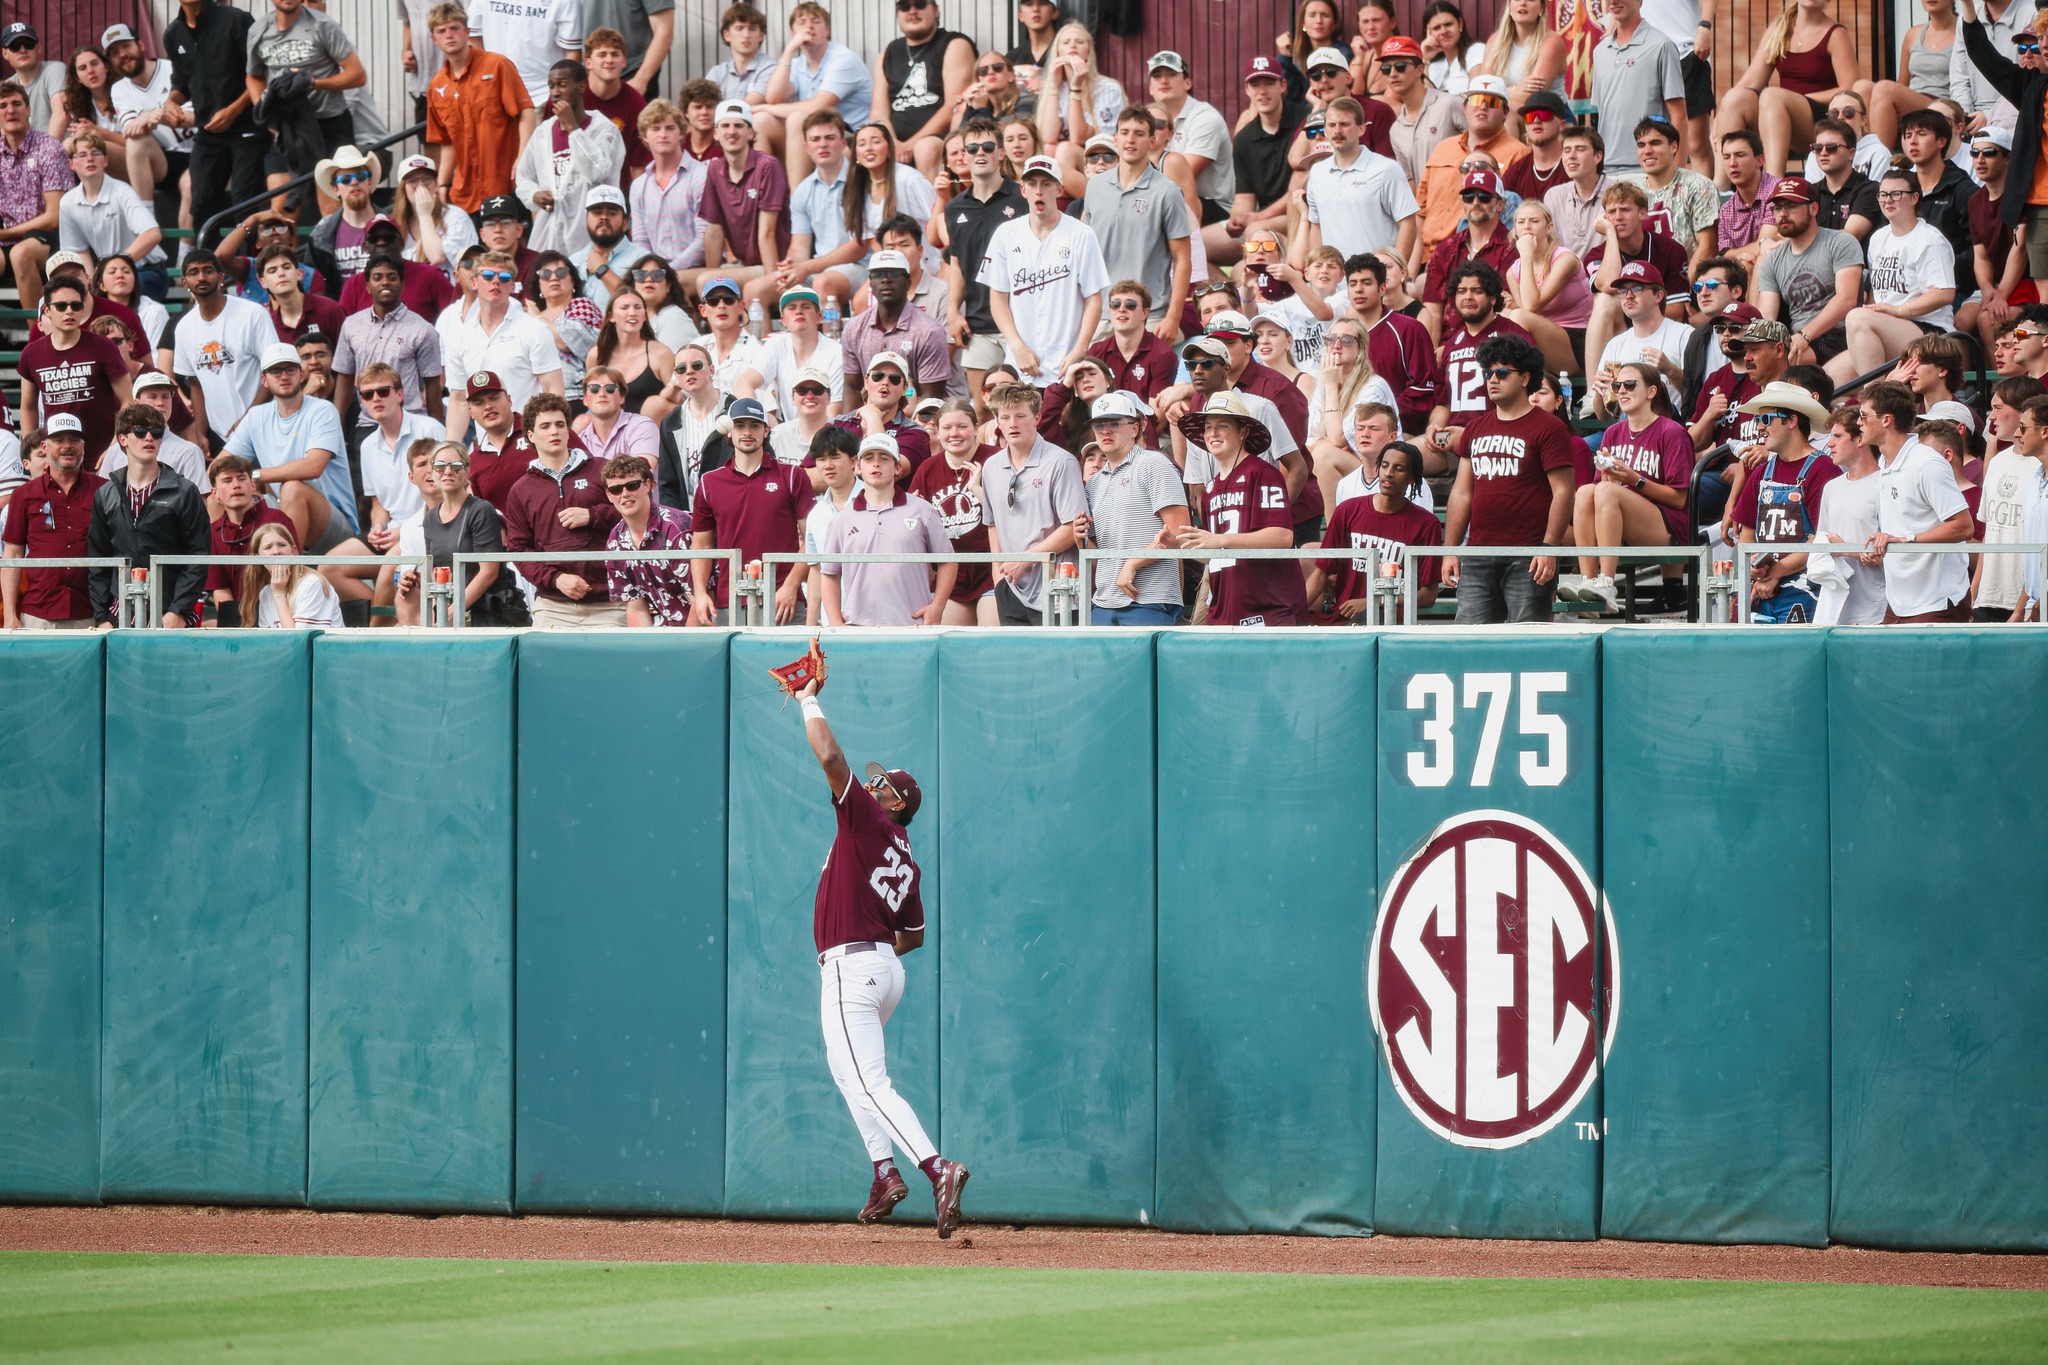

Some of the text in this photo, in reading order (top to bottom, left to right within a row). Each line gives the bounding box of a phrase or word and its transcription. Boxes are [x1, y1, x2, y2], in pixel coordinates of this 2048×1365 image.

[490, 1, 547, 19] TEXAS A&M
[1013, 264, 1071, 295] Aggies
[1450, 347, 1475, 361] TEXAS
[39, 365, 92, 383] TEXAS A&M
[45, 377, 88, 393] AGGIES
[1448, 361, 1487, 412] 12
[55, 419, 76, 428] GOOD
[1471, 435, 1526, 459] HORNS
[1633, 446, 1660, 479] A&M
[1260, 485, 1286, 509] 12
[1407, 672, 1568, 787] 375
[869, 846, 914, 913] 23
[1390, 837, 1590, 1122] SEC
